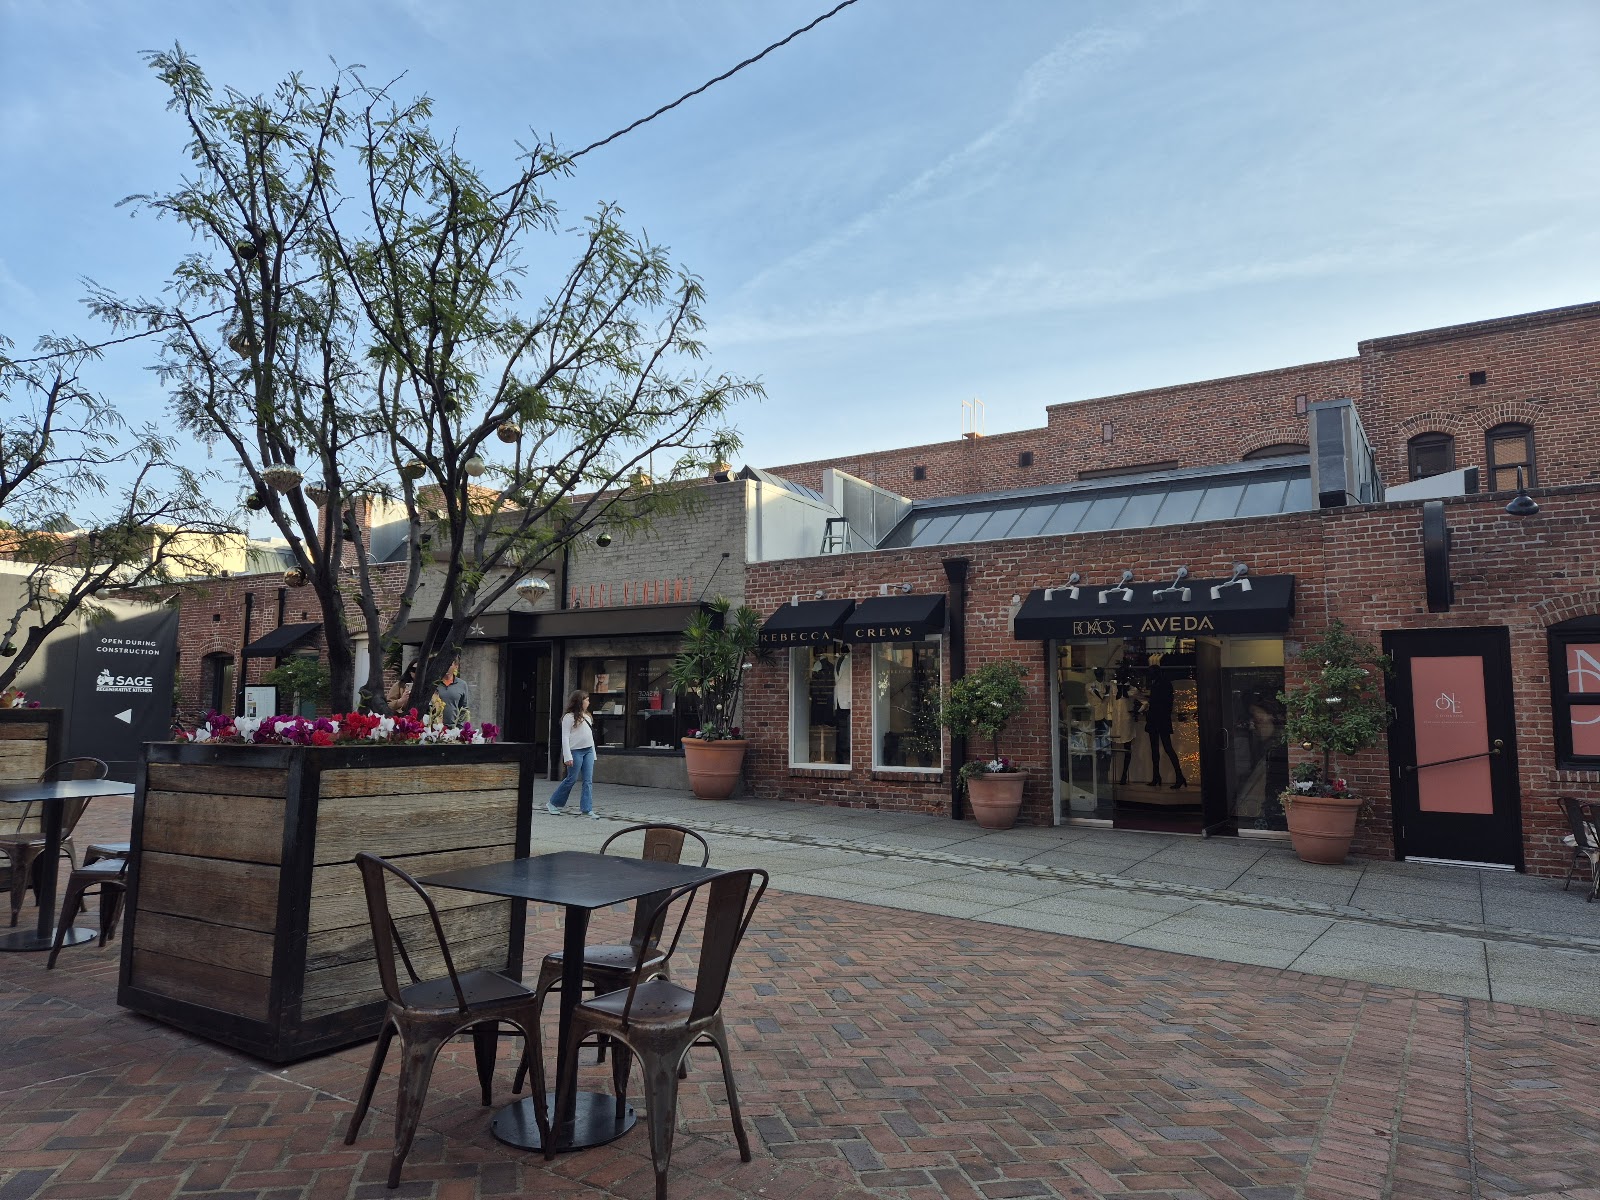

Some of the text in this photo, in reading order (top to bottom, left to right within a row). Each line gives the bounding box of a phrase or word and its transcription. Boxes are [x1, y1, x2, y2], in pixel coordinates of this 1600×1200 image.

[1140, 615, 1214, 633] AVEDA
[760, 626, 912, 642] REBECCA CREWS
[96, 646, 160, 656] CONSTRUCTION
[115, 676, 153, 686] SAGE
